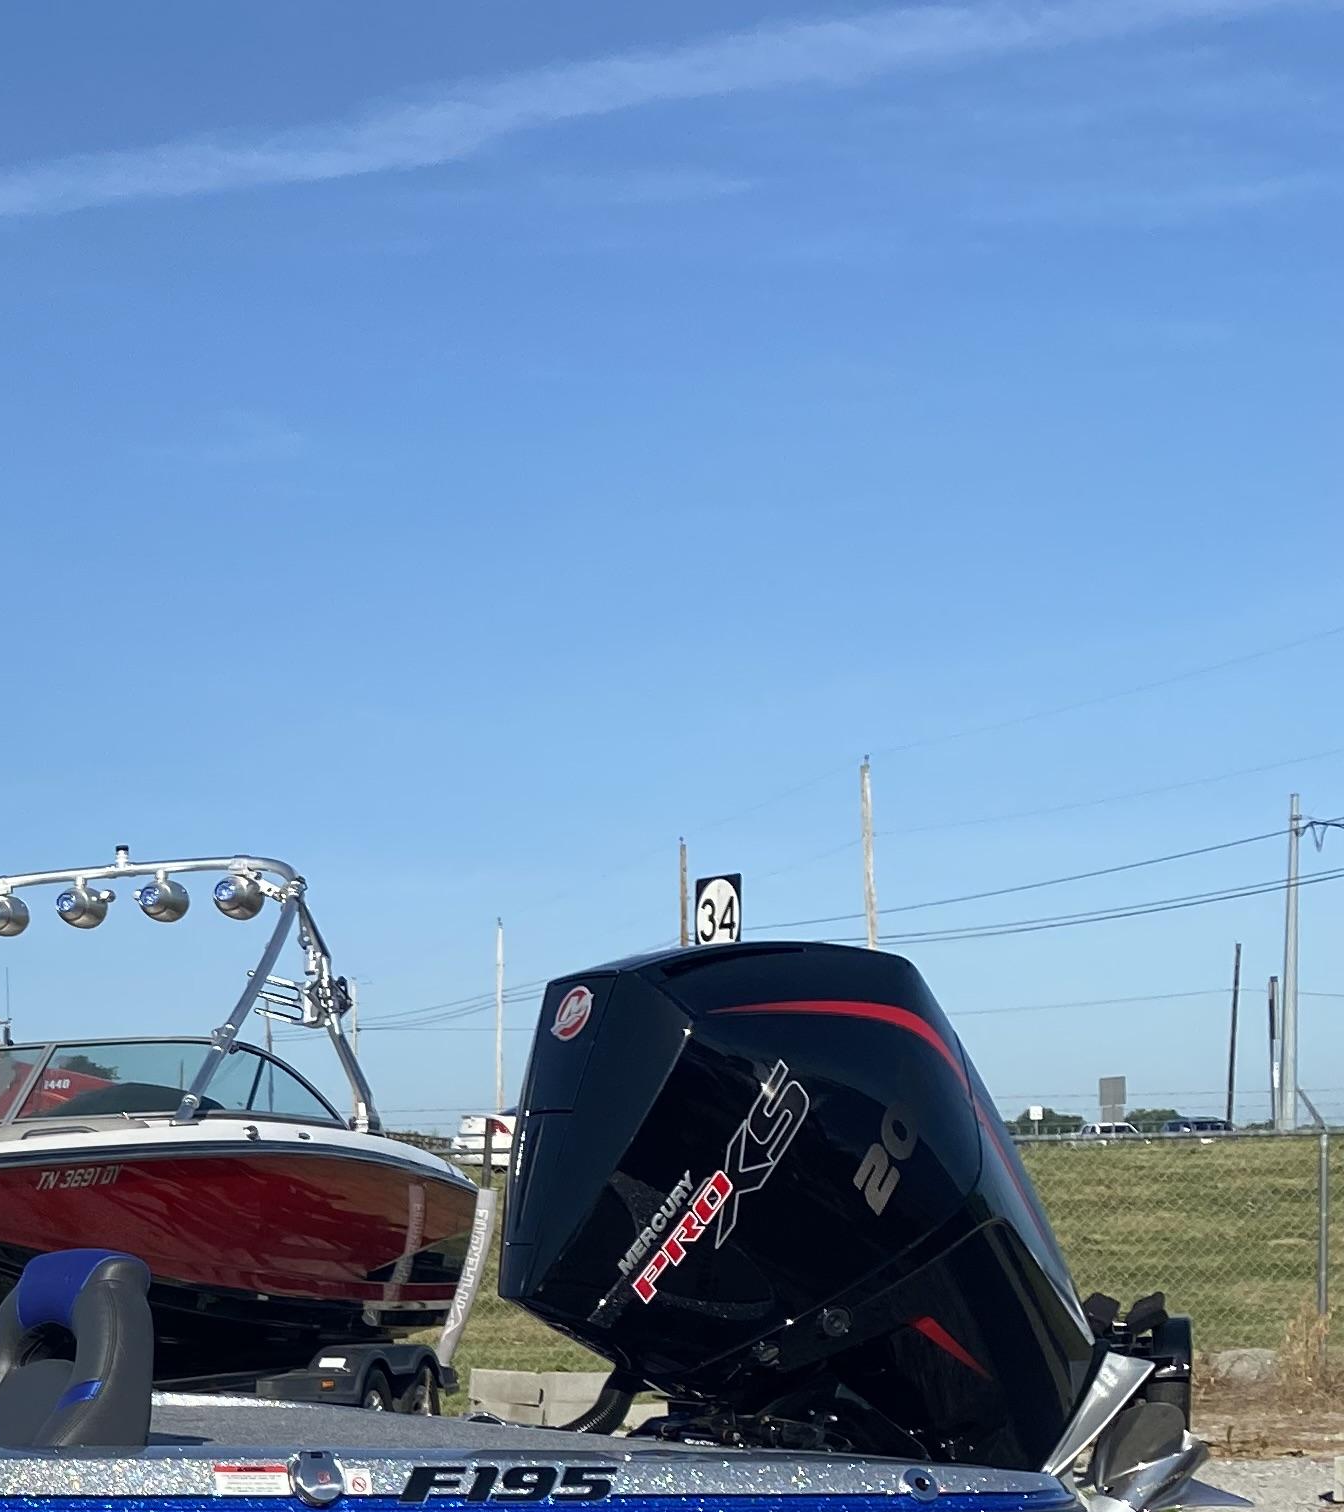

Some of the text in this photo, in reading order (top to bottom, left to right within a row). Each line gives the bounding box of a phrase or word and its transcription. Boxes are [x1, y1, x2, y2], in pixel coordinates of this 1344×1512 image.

[699, 895, 737, 943] 34
[35, 1170, 61, 1191] TN
[59, 1166, 102, 1189] 3691
[617, 1168, 694, 1277] MERCURY
[399, 1466, 618, 1502] F195
